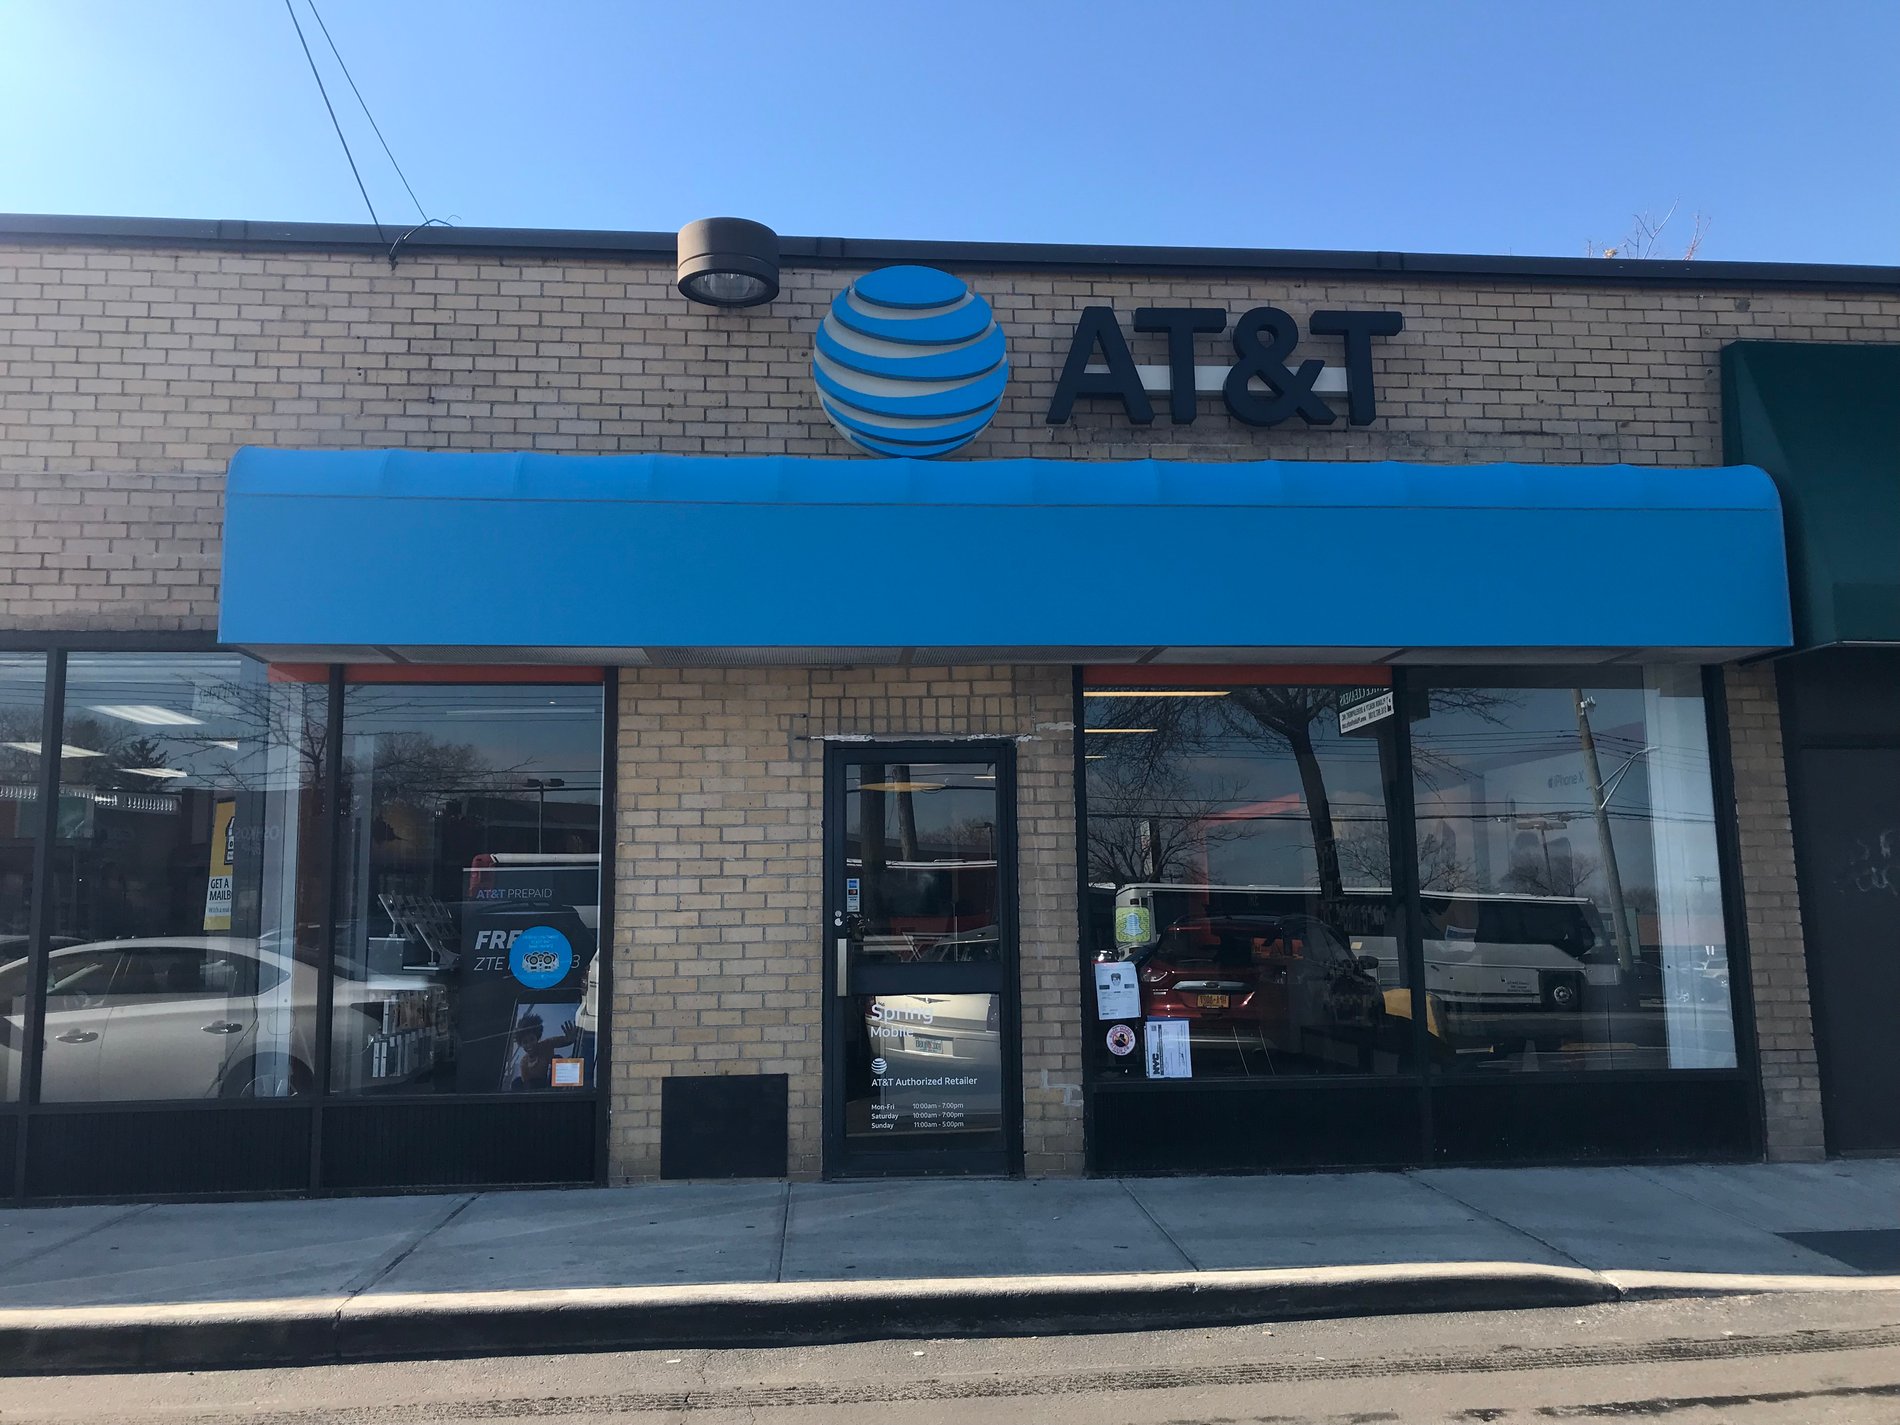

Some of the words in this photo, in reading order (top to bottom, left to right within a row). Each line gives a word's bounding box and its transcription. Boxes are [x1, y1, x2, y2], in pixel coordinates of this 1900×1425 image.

[1046, 305, 1403, 427] AT&T
[210, 878, 223, 888] GET
[224, 878, 229, 888] A
[476, 889, 506, 899] AT&T
[507, 888, 552, 898] PREPAID
[474, 930, 524, 950] FRE
[474, 956, 505, 971] ZTE
[871, 1003, 934, 1024] Spring
[870, 1026, 914, 1038] Mobile
[1152, 1053, 1160, 1075] NYC
[871, 1078, 894, 1087] AT&T
[895, 1077, 943, 1086] Authorized
[944, 1076, 978, 1085] Retailer
[942, 1102, 964, 1110] 7:00pm
[871, 1112, 898, 1120] Saturday
[942, 1112, 964, 1120] 7:00pm
[871, 1122, 894, 1130] Sunday
